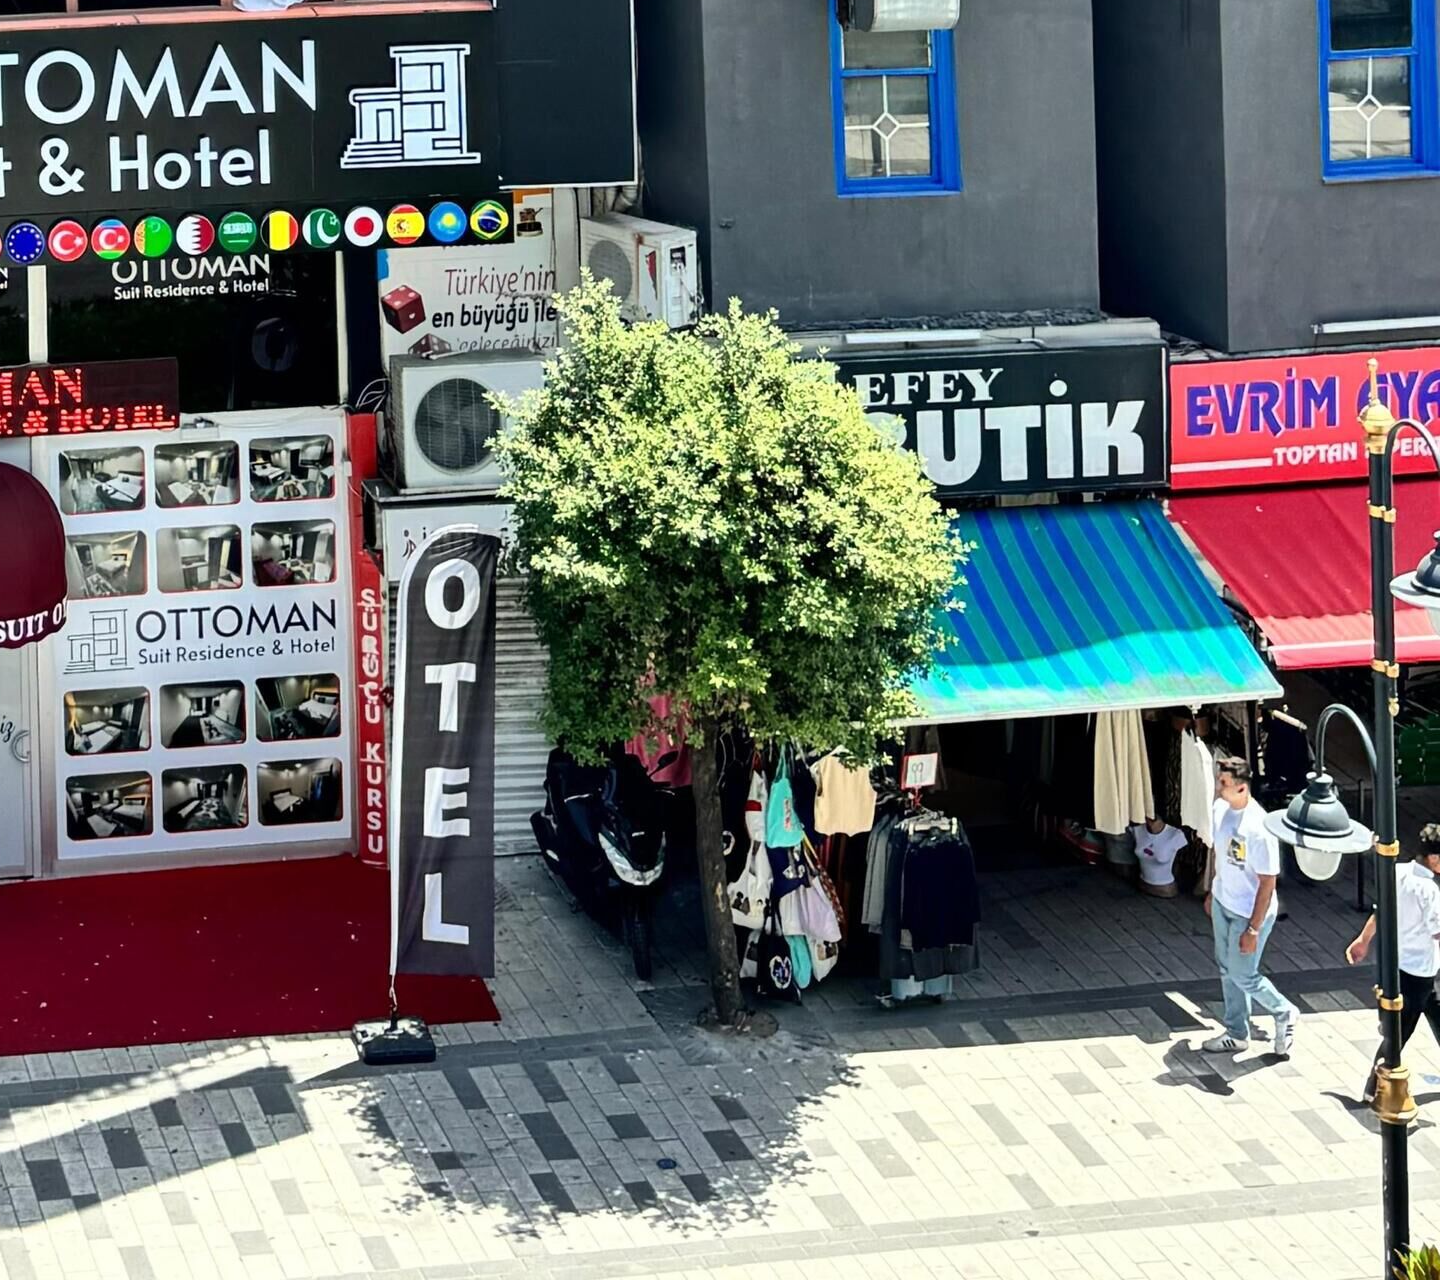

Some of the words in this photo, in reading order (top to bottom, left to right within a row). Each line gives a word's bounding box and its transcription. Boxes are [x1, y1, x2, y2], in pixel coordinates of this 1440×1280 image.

[38, 137, 86, 196] &
[109, 128, 271, 192] Hotel
[114, 286, 140, 300] Suit
[218, 280, 229, 293] &
[233, 278, 269, 292] Hotel
[445, 264, 557, 301] Türkiye'nin
[431, 312, 455, 329] en
[460, 301, 530, 333] büyüğü
[535, 298, 558, 323] ile
[1186, 367, 1341, 438] EVRİM
[1273, 441, 1358, 466] TOPTAN
[135, 599, 337, 643] OTTOMAN
[138, 647, 171, 665] Suit
[176, 643, 266, 663] Residence
[271, 639, 284, 656] &
[290, 636, 336, 654] Hotel
[420, 555, 482, 948] OTEL
[365, 742, 384, 854] KURSU
